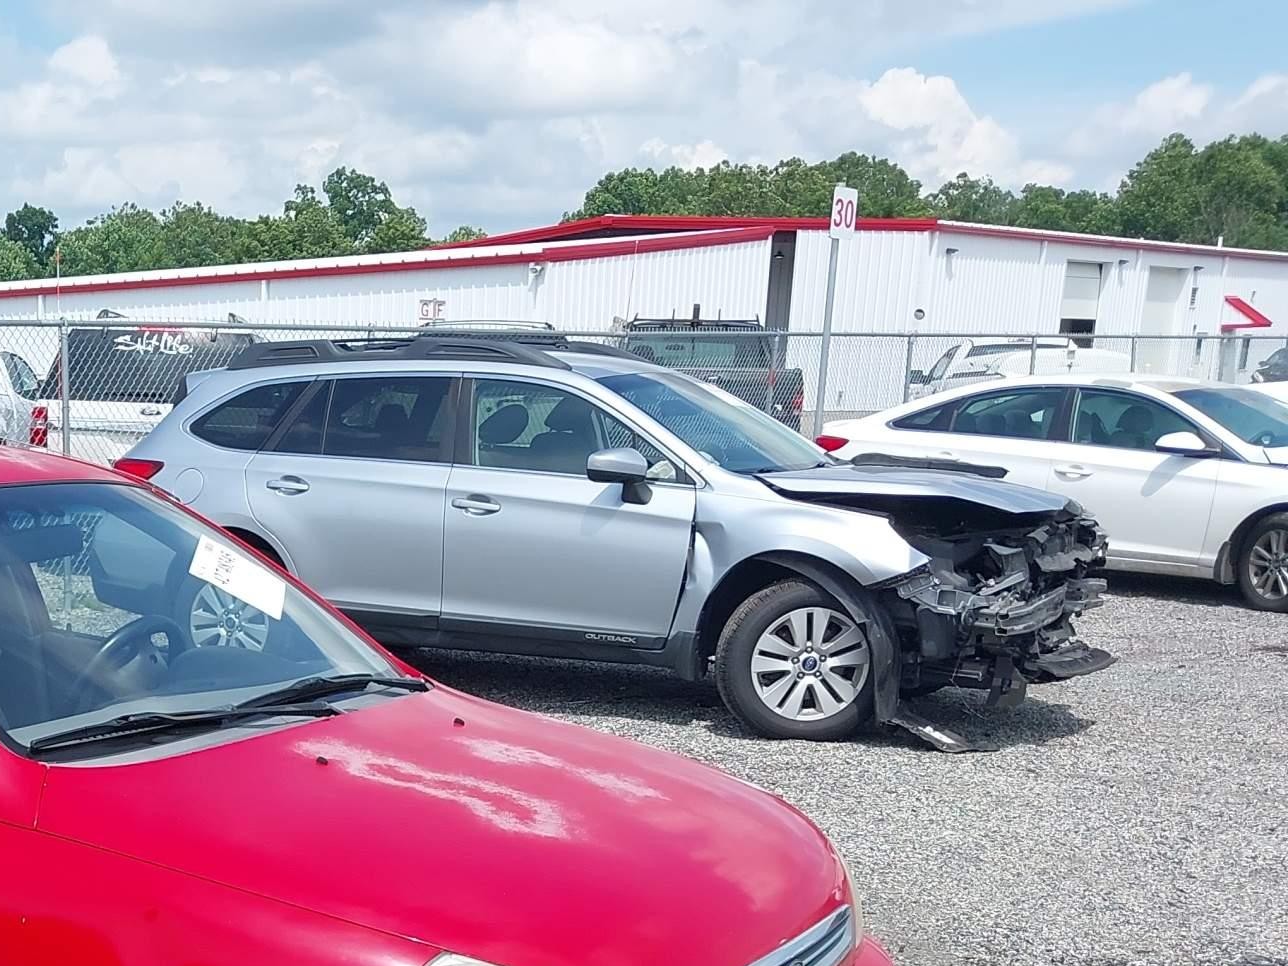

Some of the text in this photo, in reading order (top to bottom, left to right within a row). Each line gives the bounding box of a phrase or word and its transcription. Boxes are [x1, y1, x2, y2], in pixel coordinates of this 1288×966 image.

[834, 198, 854, 229] 30
[421, 302, 429, 317] G
[437, 303, 444, 317] F
[584, 632, 638, 644] OUTBACK
